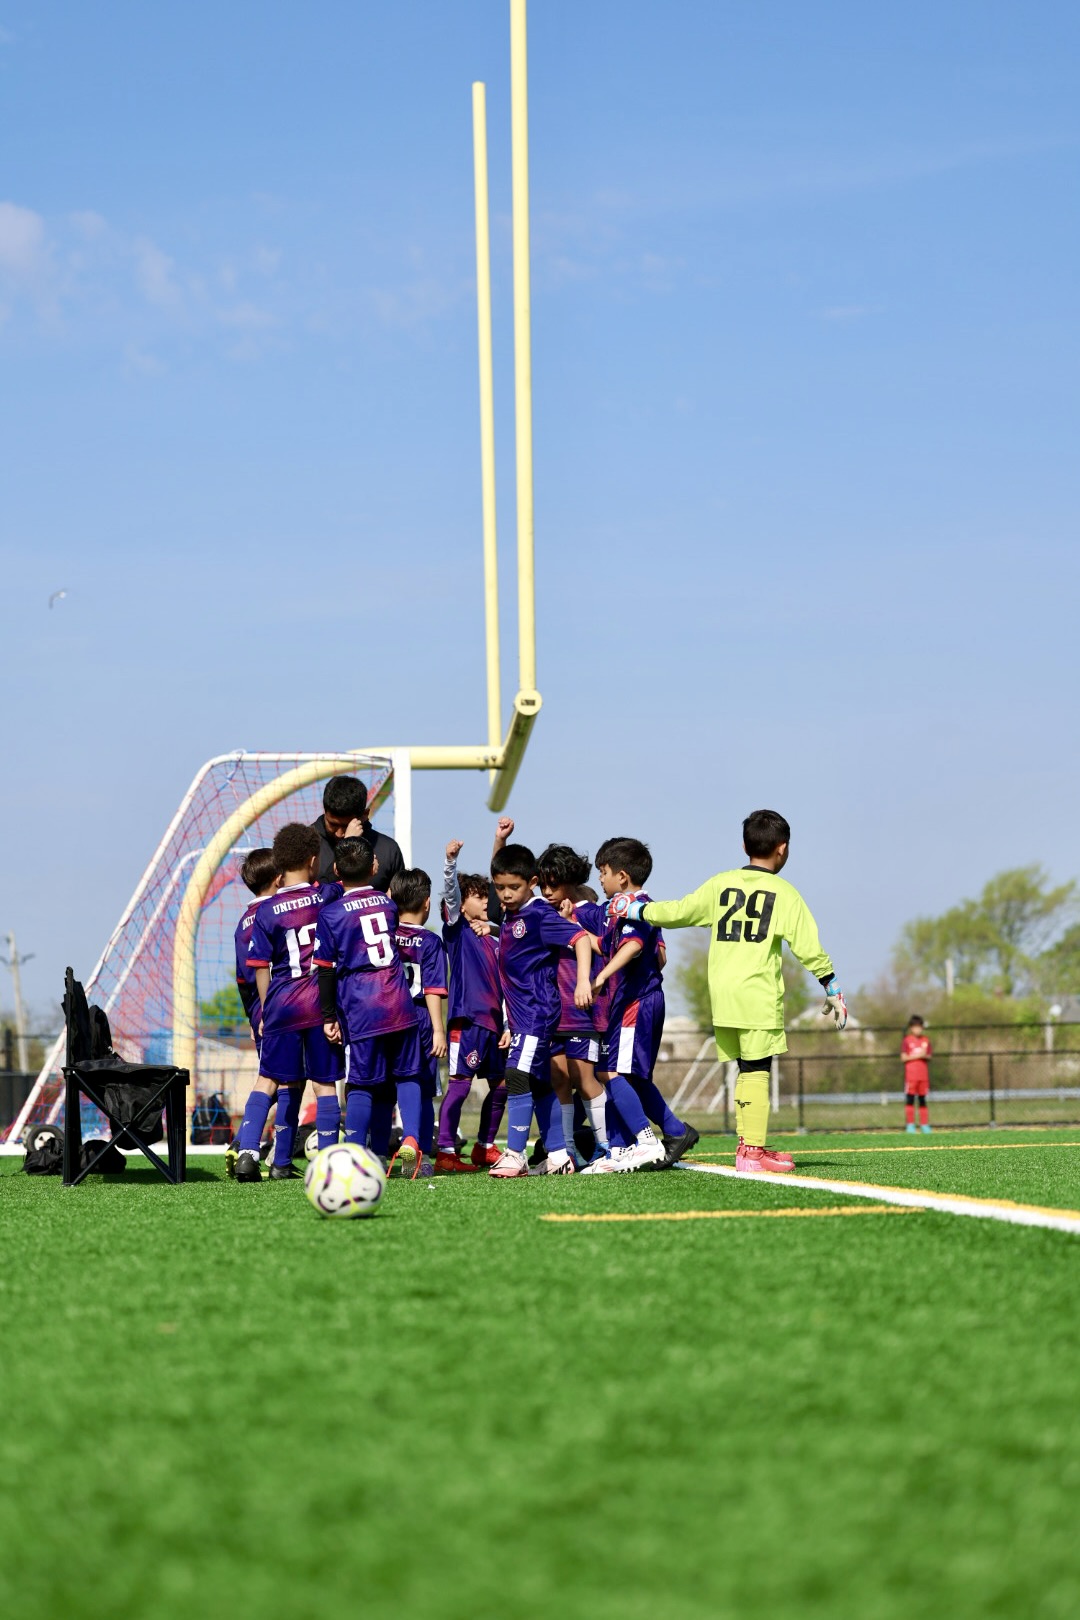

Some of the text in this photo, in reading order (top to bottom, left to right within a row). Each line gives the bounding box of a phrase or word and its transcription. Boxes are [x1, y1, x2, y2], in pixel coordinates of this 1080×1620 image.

[273, 893, 323, 914] UNITED FC
[343, 895, 389, 911] UNITED FC
[717, 887, 776, 943] 29
[359, 911, 394, 968] 5
[411, 936, 422, 947] FC
